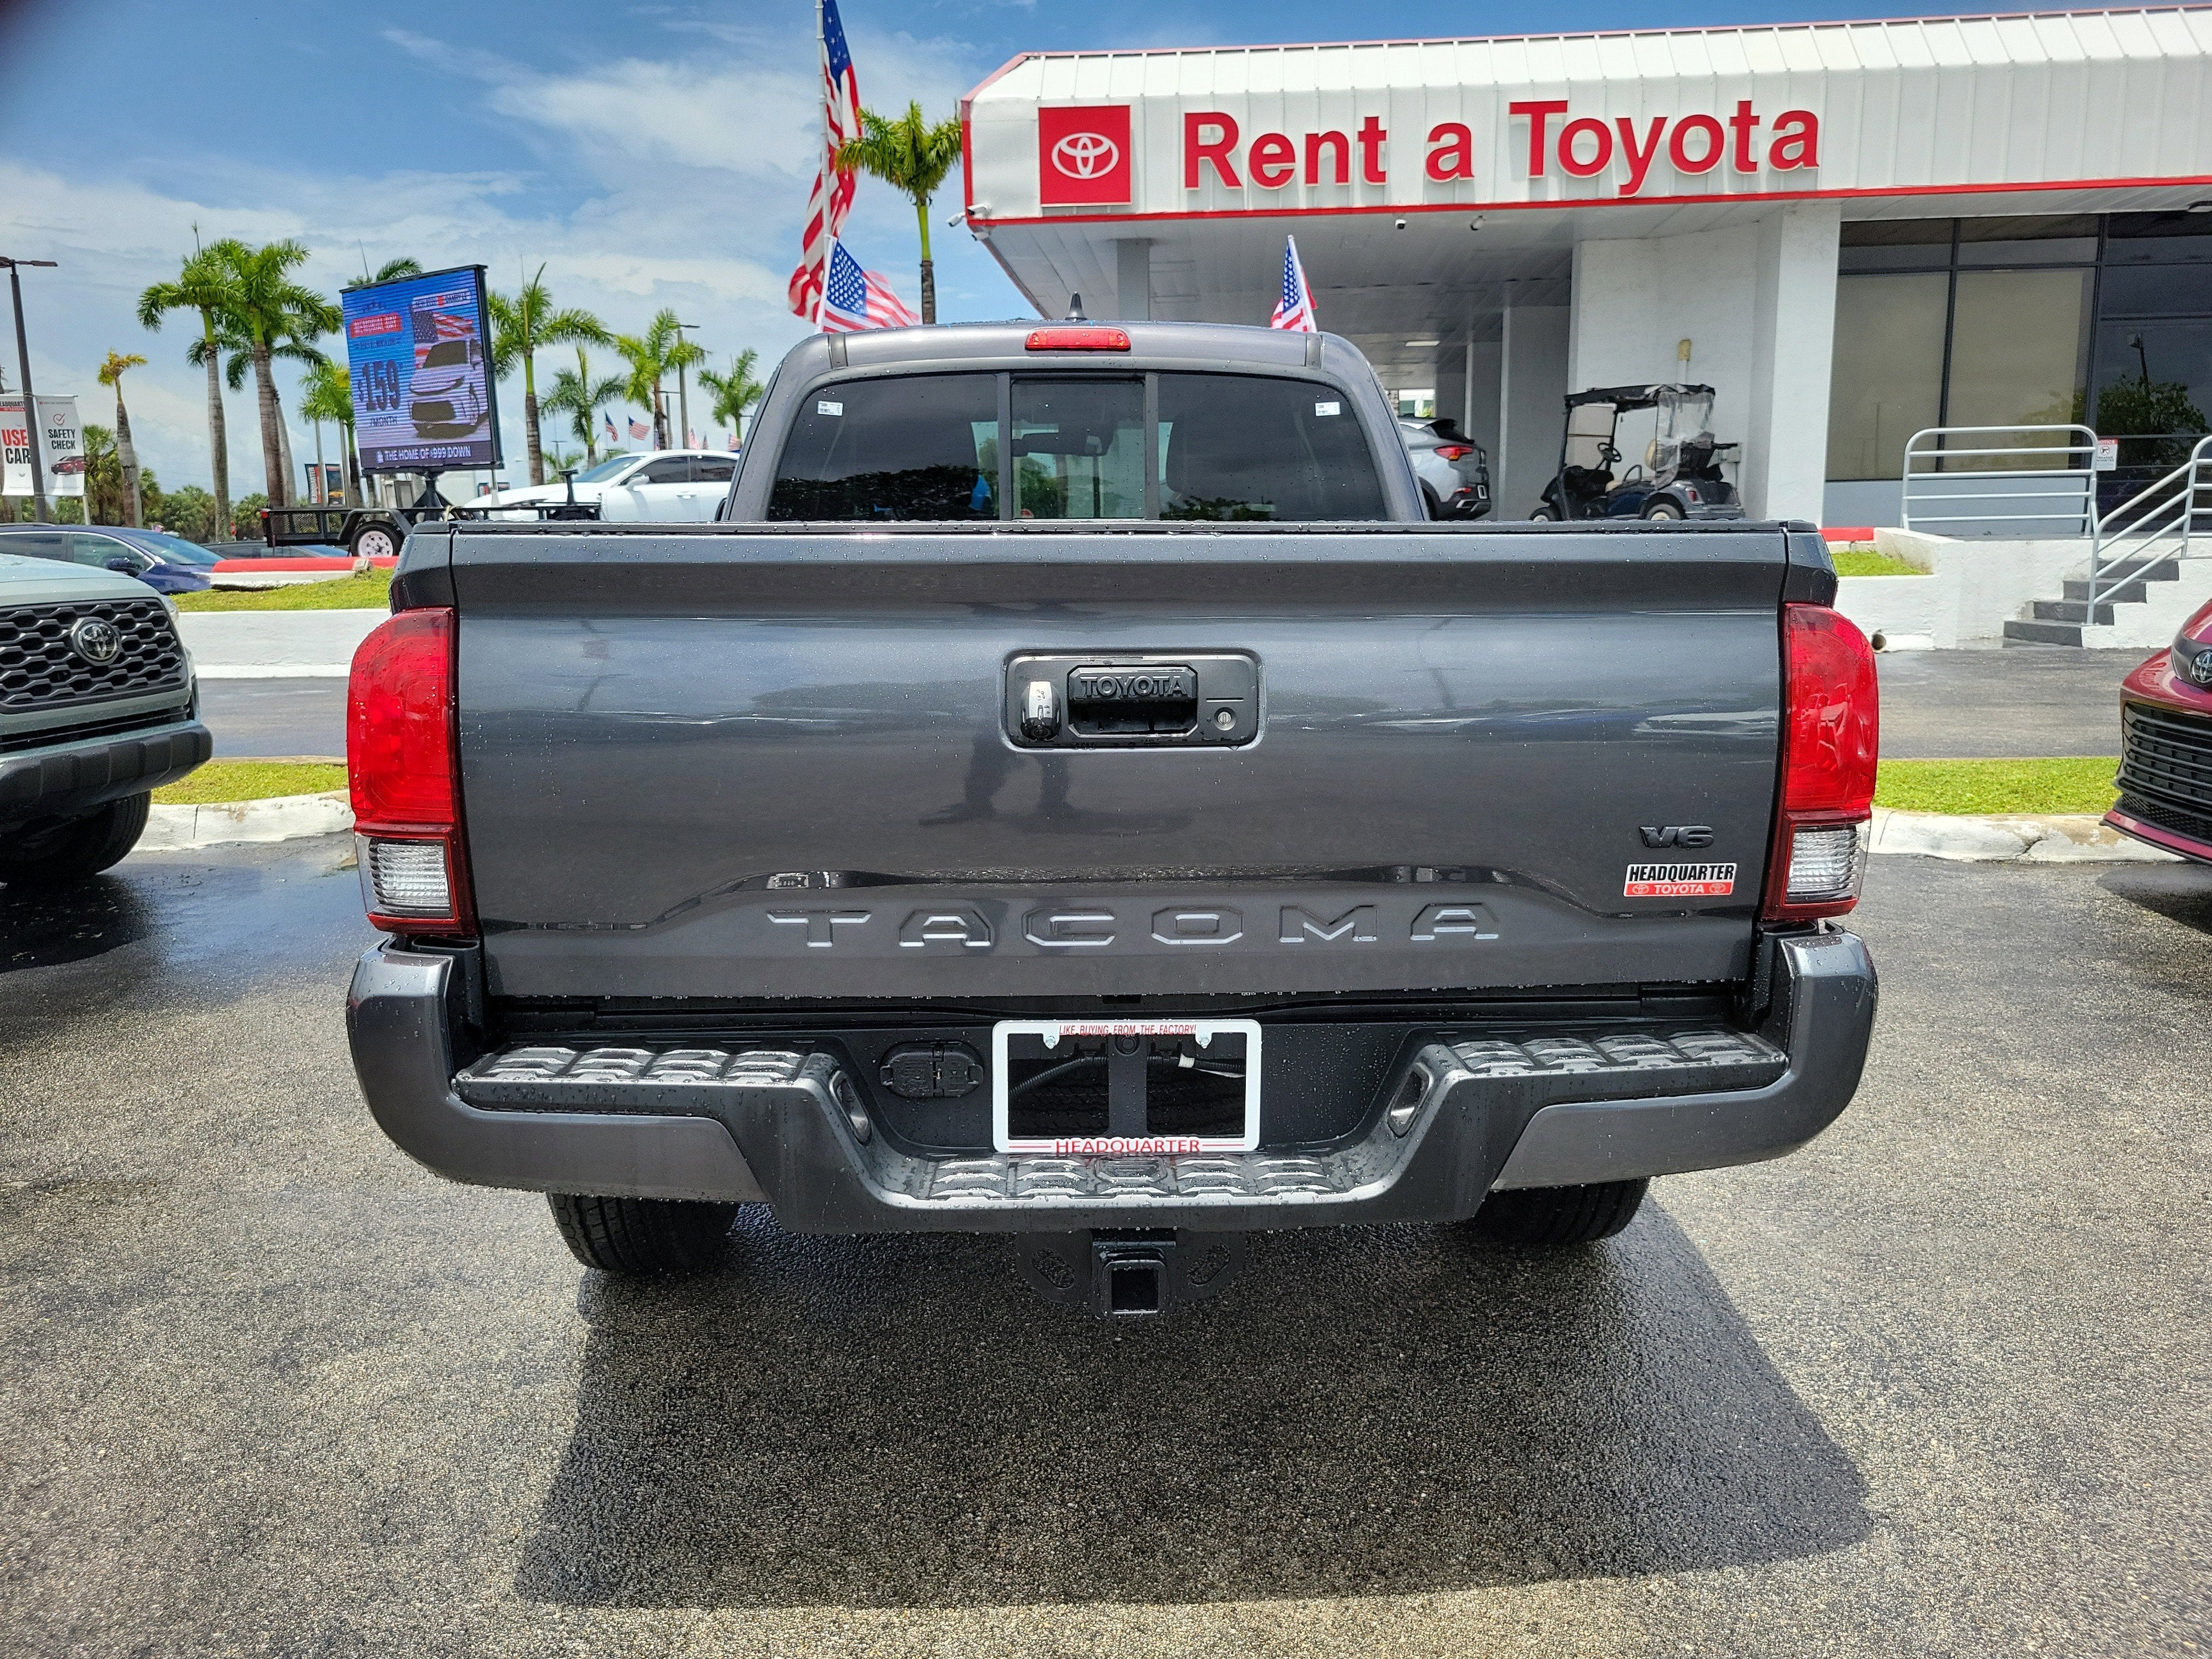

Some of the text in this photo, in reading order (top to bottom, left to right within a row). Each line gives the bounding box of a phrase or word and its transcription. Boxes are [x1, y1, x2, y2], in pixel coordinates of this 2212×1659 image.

[1184, 100, 1820, 197] Rent a Toyota
[2, 429, 29, 446] USE
[48, 428, 76, 439] SAFETY
[51, 440, 76, 449] CHECK
[5, 448, 31, 464] CAR
[385, 450, 398, 461] THE
[399, 448, 419, 460] HOME
[420, 448, 430, 459] OF
[447, 445, 471, 458] DOWN
[1080, 675, 1188, 697] TOYOTA
[1639, 825, 1714, 849] V6
[1628, 865, 1734, 882] HEADQUARTER
[1654, 884, 1705, 894] TOYOTA
[766, 903, 1499, 947] TACOMA
[1059, 1024, 1197, 1035] LIKE BUYING FROM THE FACTORY!
[1056, 1139, 1200, 1153] HEADQUARTER
